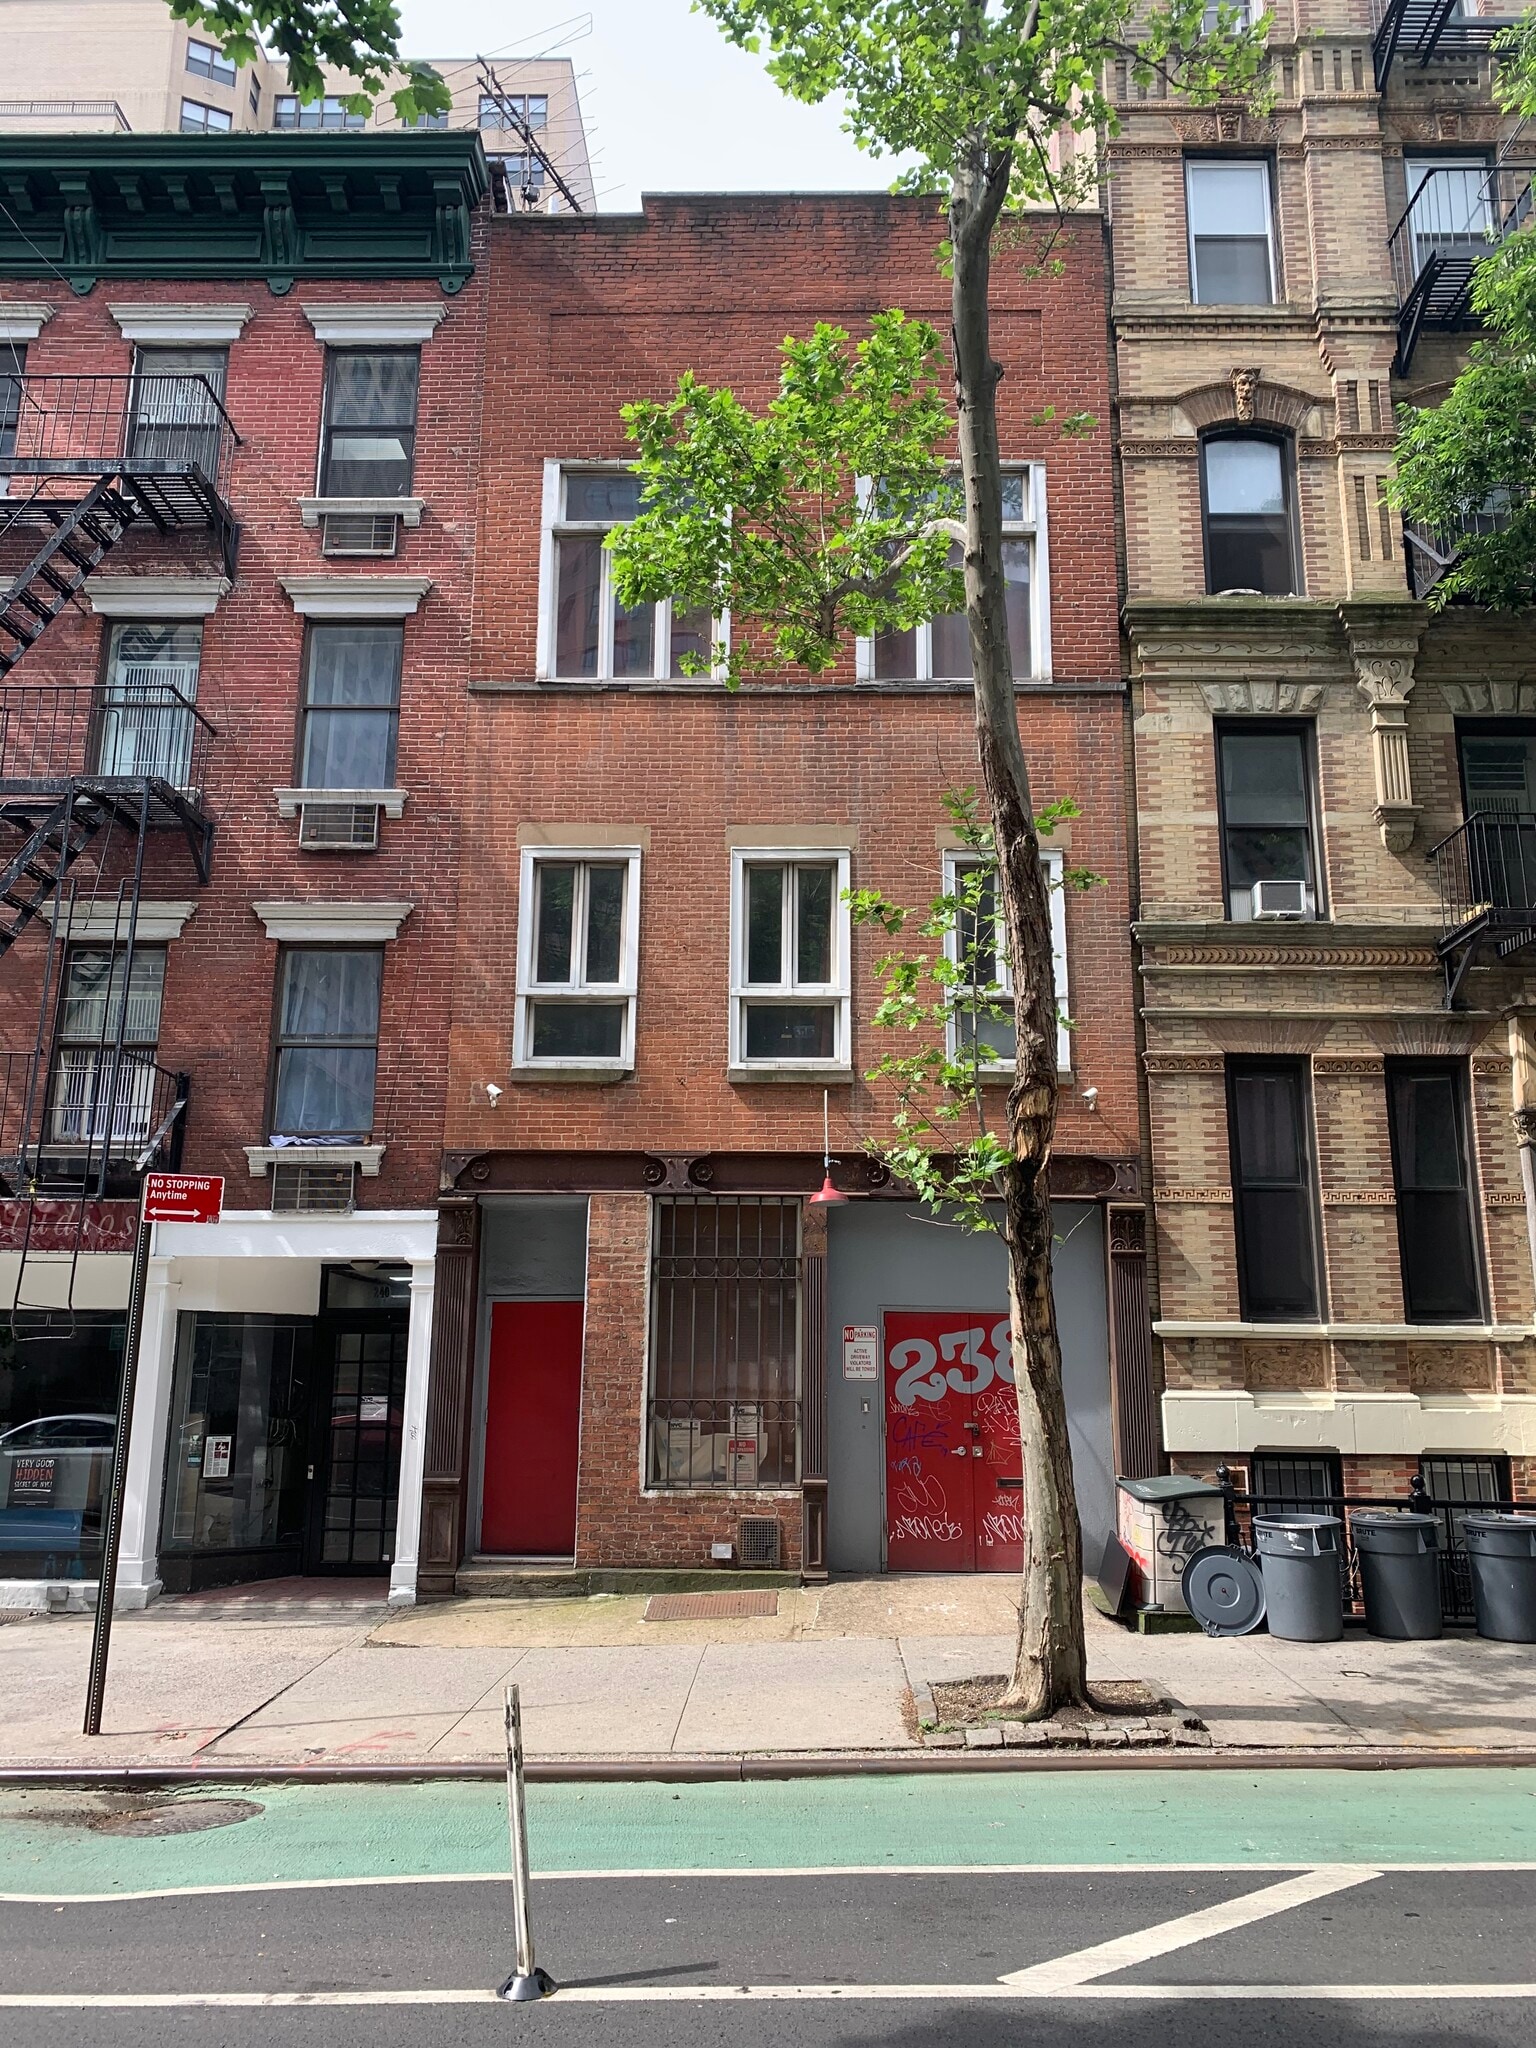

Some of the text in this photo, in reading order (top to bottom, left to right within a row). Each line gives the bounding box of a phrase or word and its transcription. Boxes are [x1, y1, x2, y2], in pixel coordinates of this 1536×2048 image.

[151, 1178, 211, 1191] NO STOPPING
[150, 1189, 188, 1201] Anytime
[0, 1204, 136, 1236] tudios
[844, 1329, 876, 1341] NO PARKING
[17, 1459, 55, 1468] VERY GOOD
[16, 1468, 53, 1480] HIDDEN
[1356, 1527, 1377, 1537] BRUTE
[1465, 1528, 1488, 1538] BRUTE
